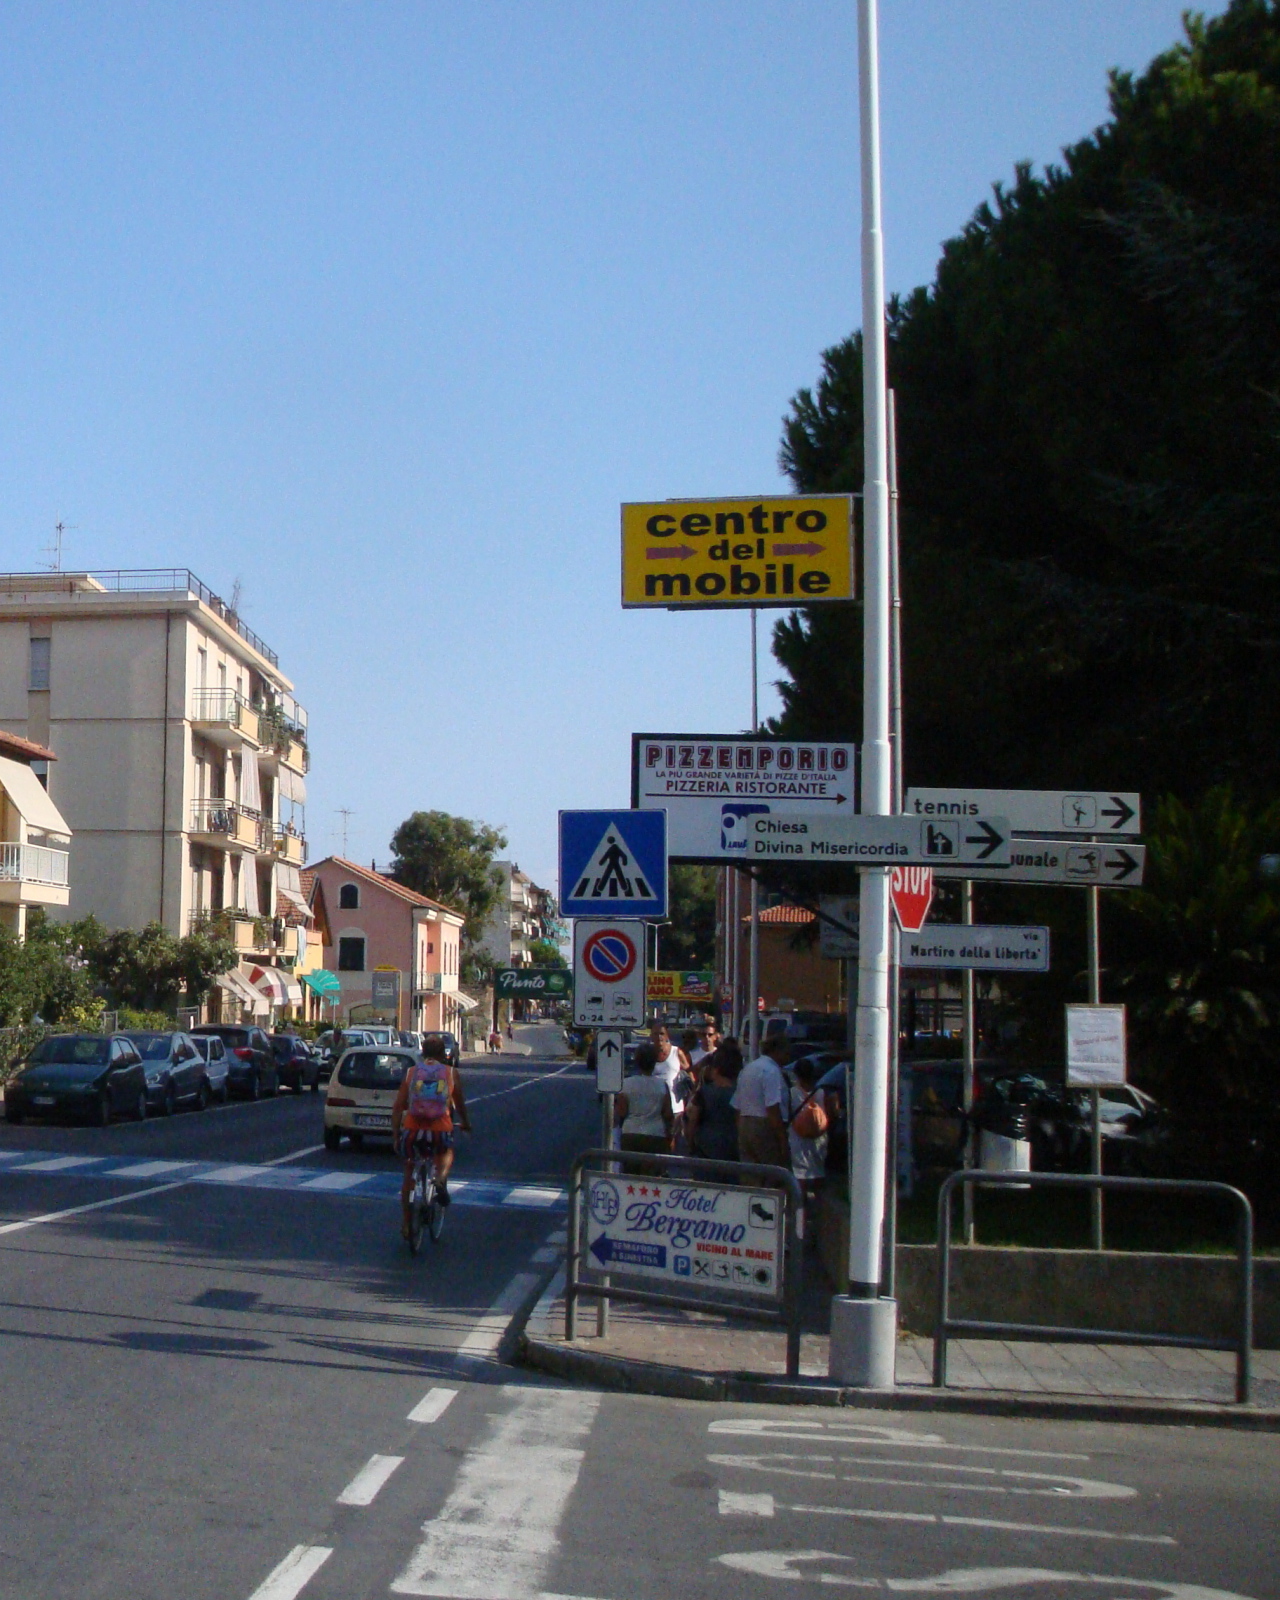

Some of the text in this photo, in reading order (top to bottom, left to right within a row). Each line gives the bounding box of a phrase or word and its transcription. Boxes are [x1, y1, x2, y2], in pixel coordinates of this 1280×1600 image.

[646, 504, 828, 538] centro
[708, 538, 765, 561] del
[645, 563, 831, 596] mobile
[646, 745, 849, 771] PIZZEMPORIO
[655, 770, 667, 778] LA
[686, 771, 722, 779] GRANDE
[763, 772, 773, 780] DI
[775, 773, 798, 781] PIZZE
[801, 773, 837, 781] D'ITALIA
[666, 780, 827, 794] PIZZERIA RISTORANTE
[914, 799, 979, 815] tennis
[755, 820, 808, 833] Chiesa
[755, 840, 908, 856] Divina Misericordia
[893, 867, 928, 896] STOP
[1023, 932, 1039, 941] via
[910, 944, 955, 958] Martire
[960, 945, 991, 959] della
[500, 971, 546, 988] Punto
[665, 1187, 726, 1213] Hotel
[625, 1201, 746, 1249] Bergamo
[696, 1242, 774, 1261] VICINO AL MARE
